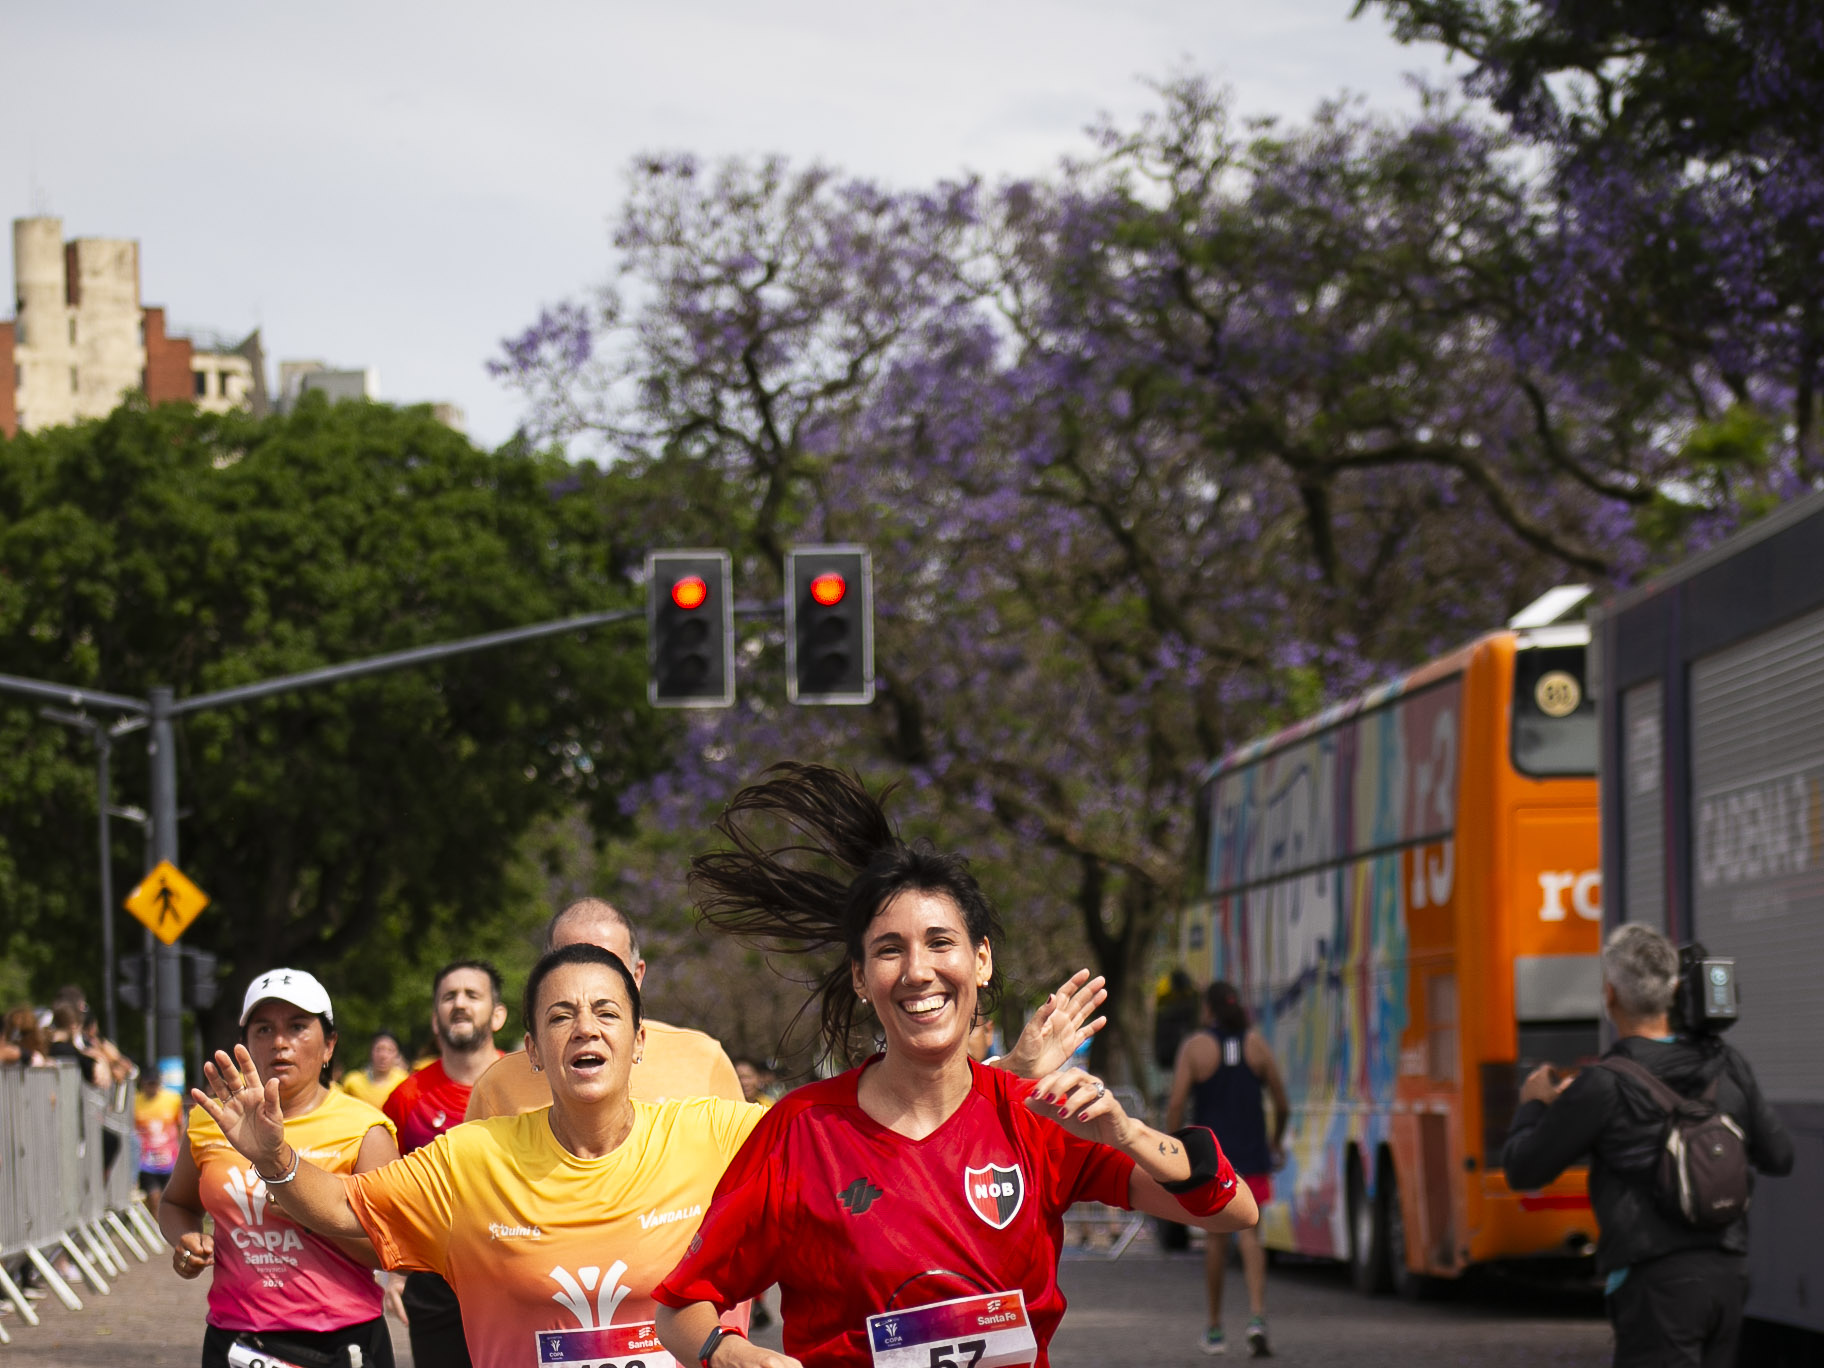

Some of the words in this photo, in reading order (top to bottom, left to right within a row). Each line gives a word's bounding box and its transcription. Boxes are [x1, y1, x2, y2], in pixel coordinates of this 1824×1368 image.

[974, 1182, 1015, 1199] NOB
[637, 1205, 702, 1230] VANDALIA
[230, 1227, 304, 1252] COPA
[977, 1315, 1004, 1326] Santa
[1004, 1312, 1017, 1323] Fe
[628, 1339, 652, 1350] Santa
[884, 1336, 903, 1344] COPA
